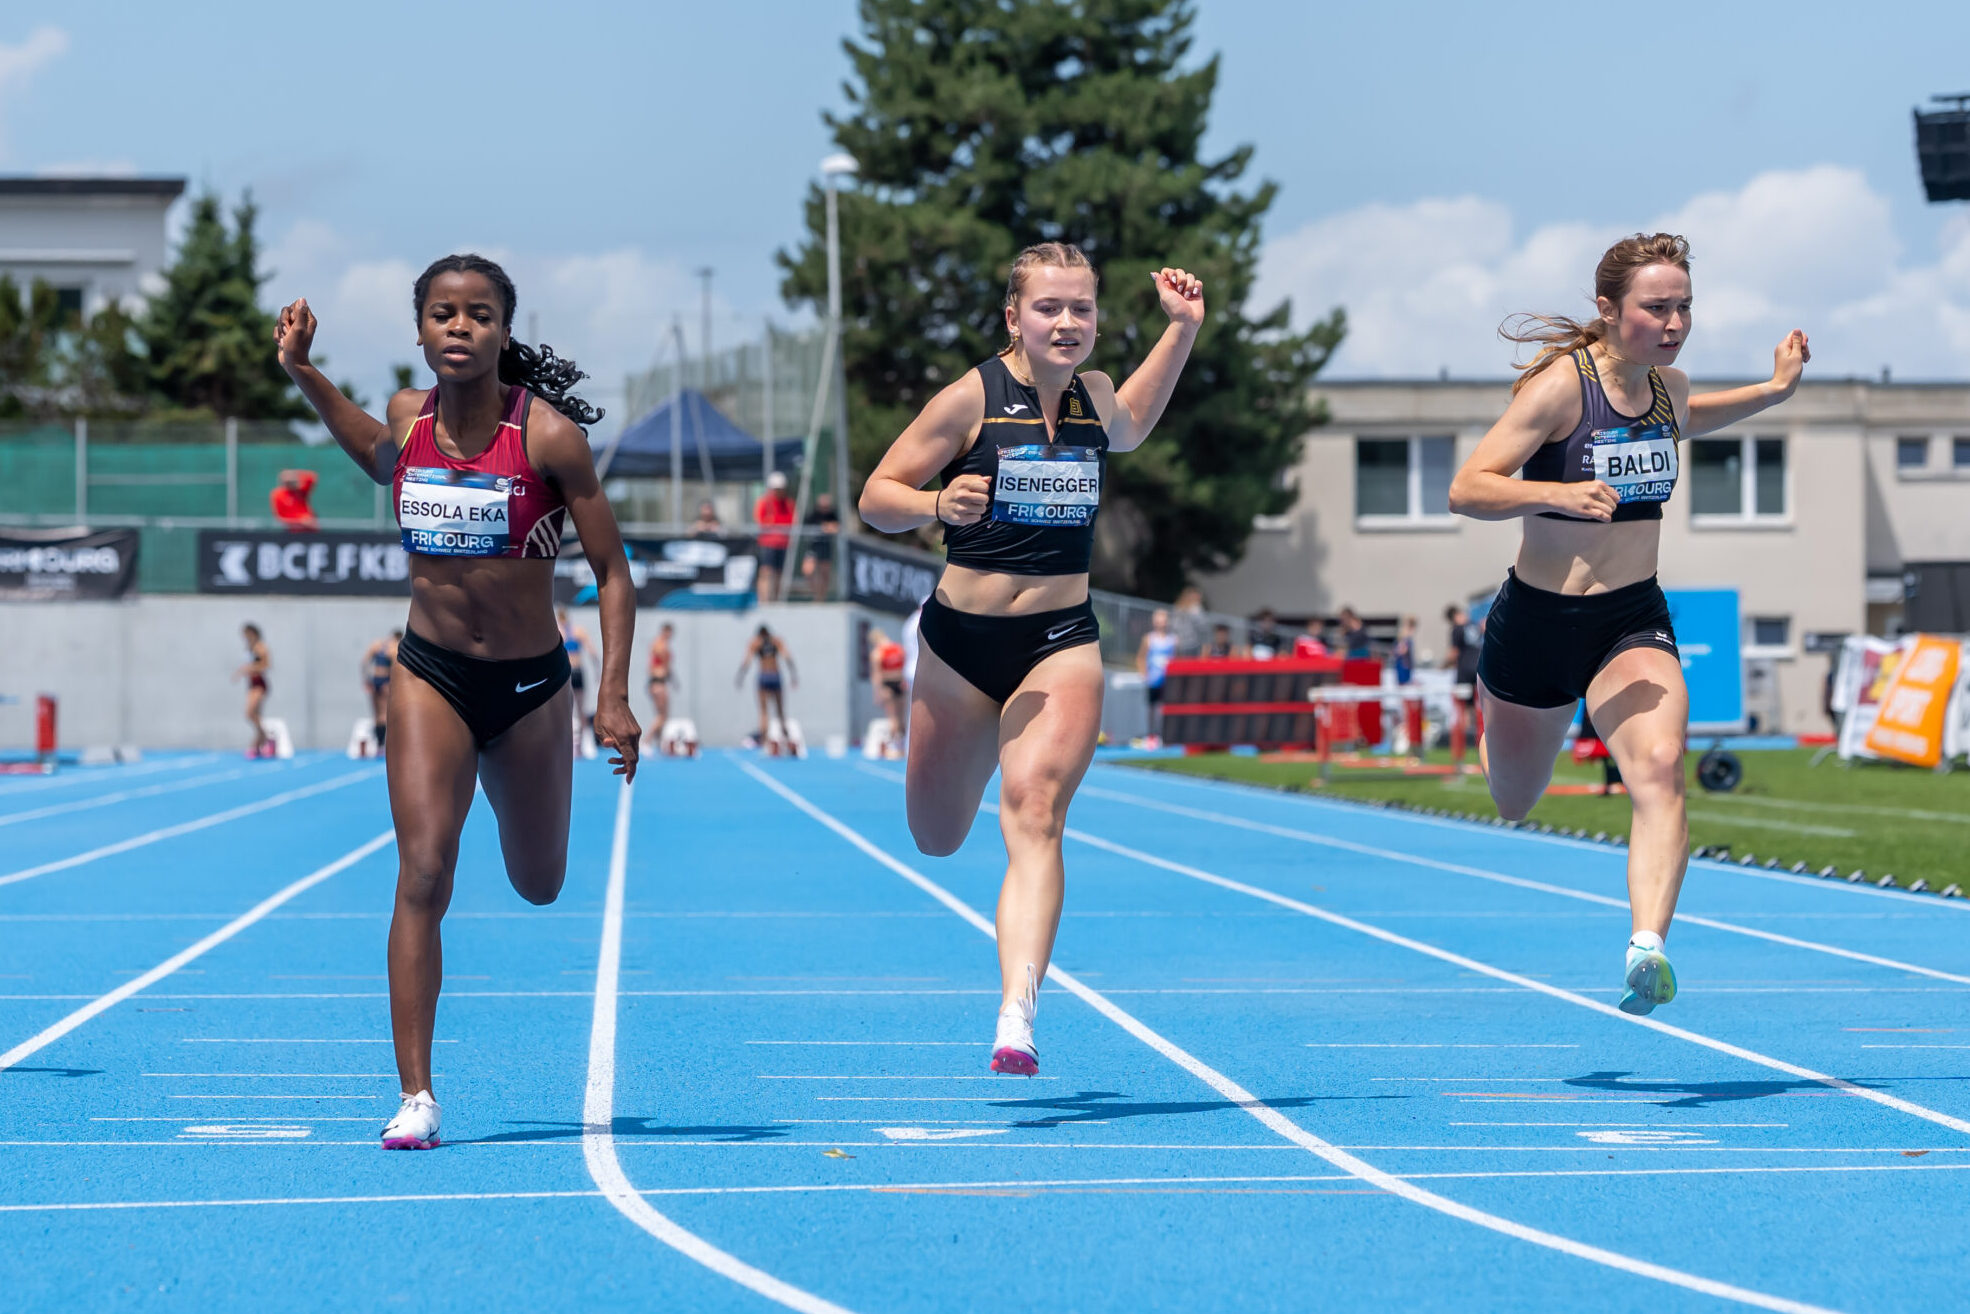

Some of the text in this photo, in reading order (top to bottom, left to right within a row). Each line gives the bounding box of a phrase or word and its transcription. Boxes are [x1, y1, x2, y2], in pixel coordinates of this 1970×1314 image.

[1607, 450, 1671, 478] BALDI
[999, 477, 1098, 493] ISENEGGER
[402, 500, 507, 522] ESSOLA EKA
